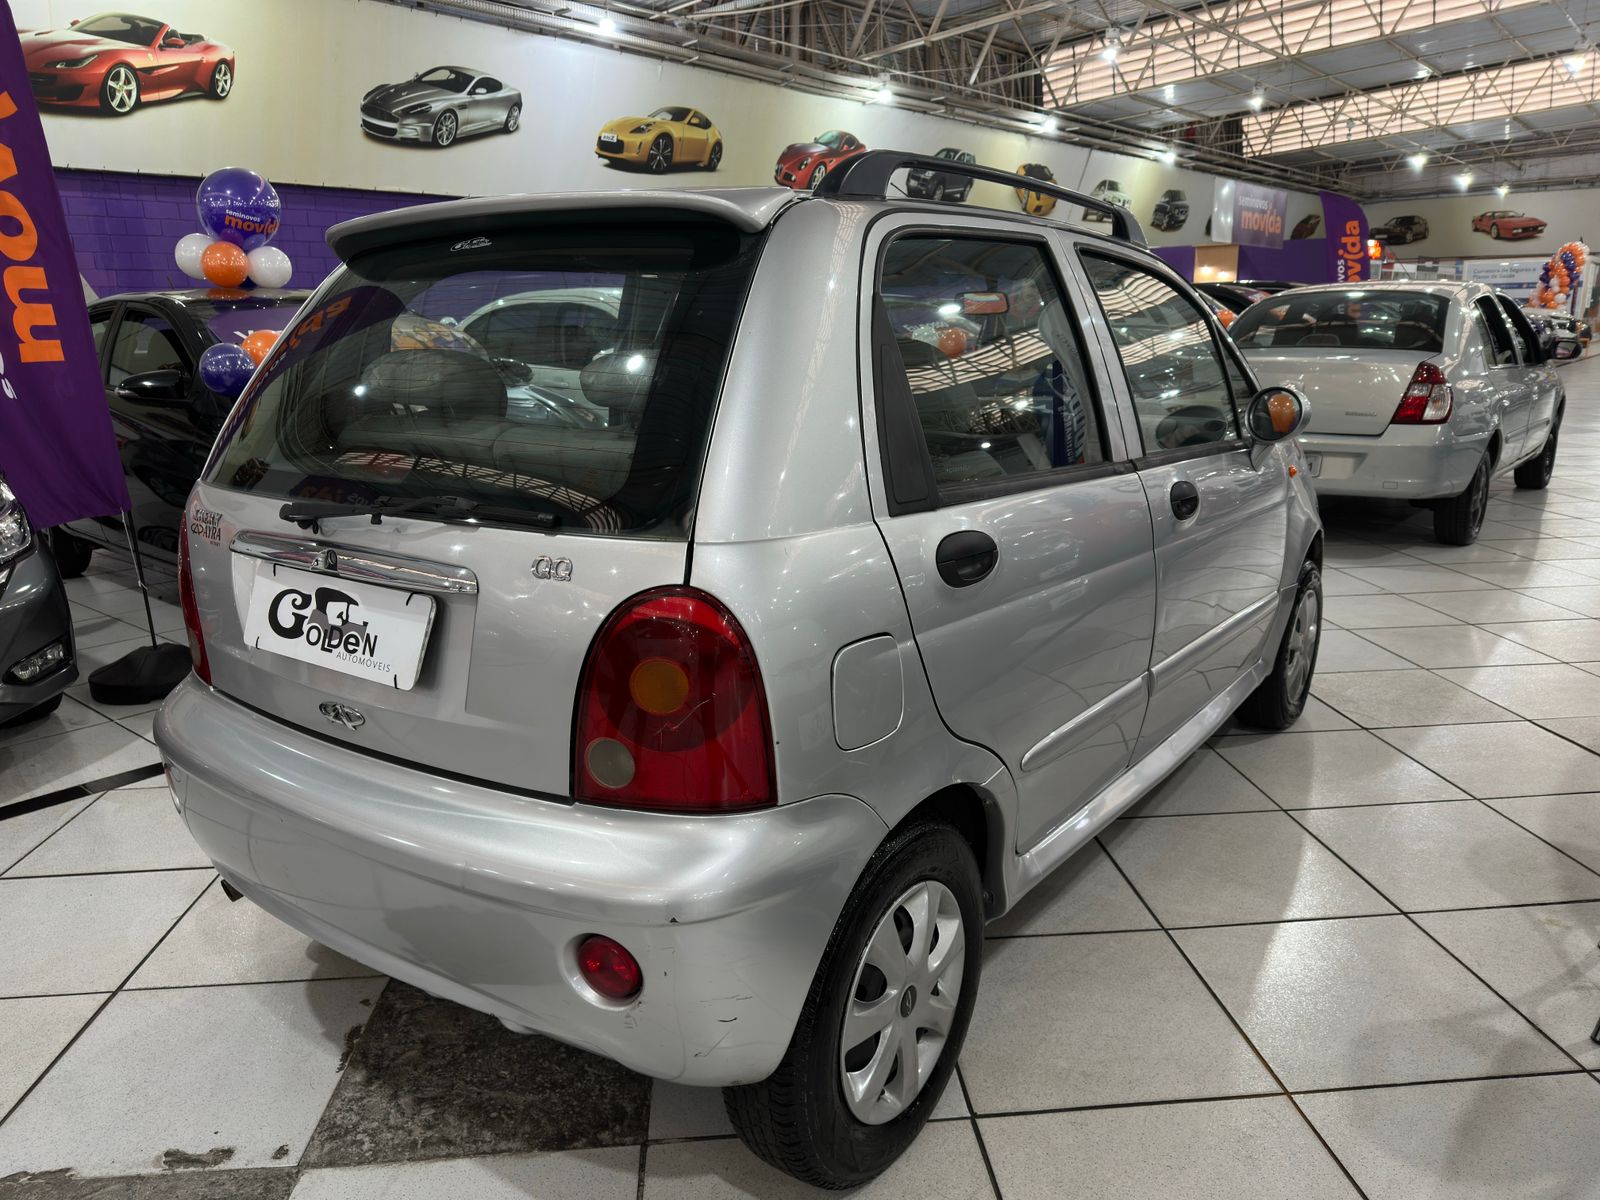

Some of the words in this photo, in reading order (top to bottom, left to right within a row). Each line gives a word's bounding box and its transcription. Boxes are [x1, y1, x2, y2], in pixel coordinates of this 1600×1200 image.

[225, 209, 261, 222] seminovos
[1241, 203, 1281, 236] movida
[531, 555, 573, 582] QQ
